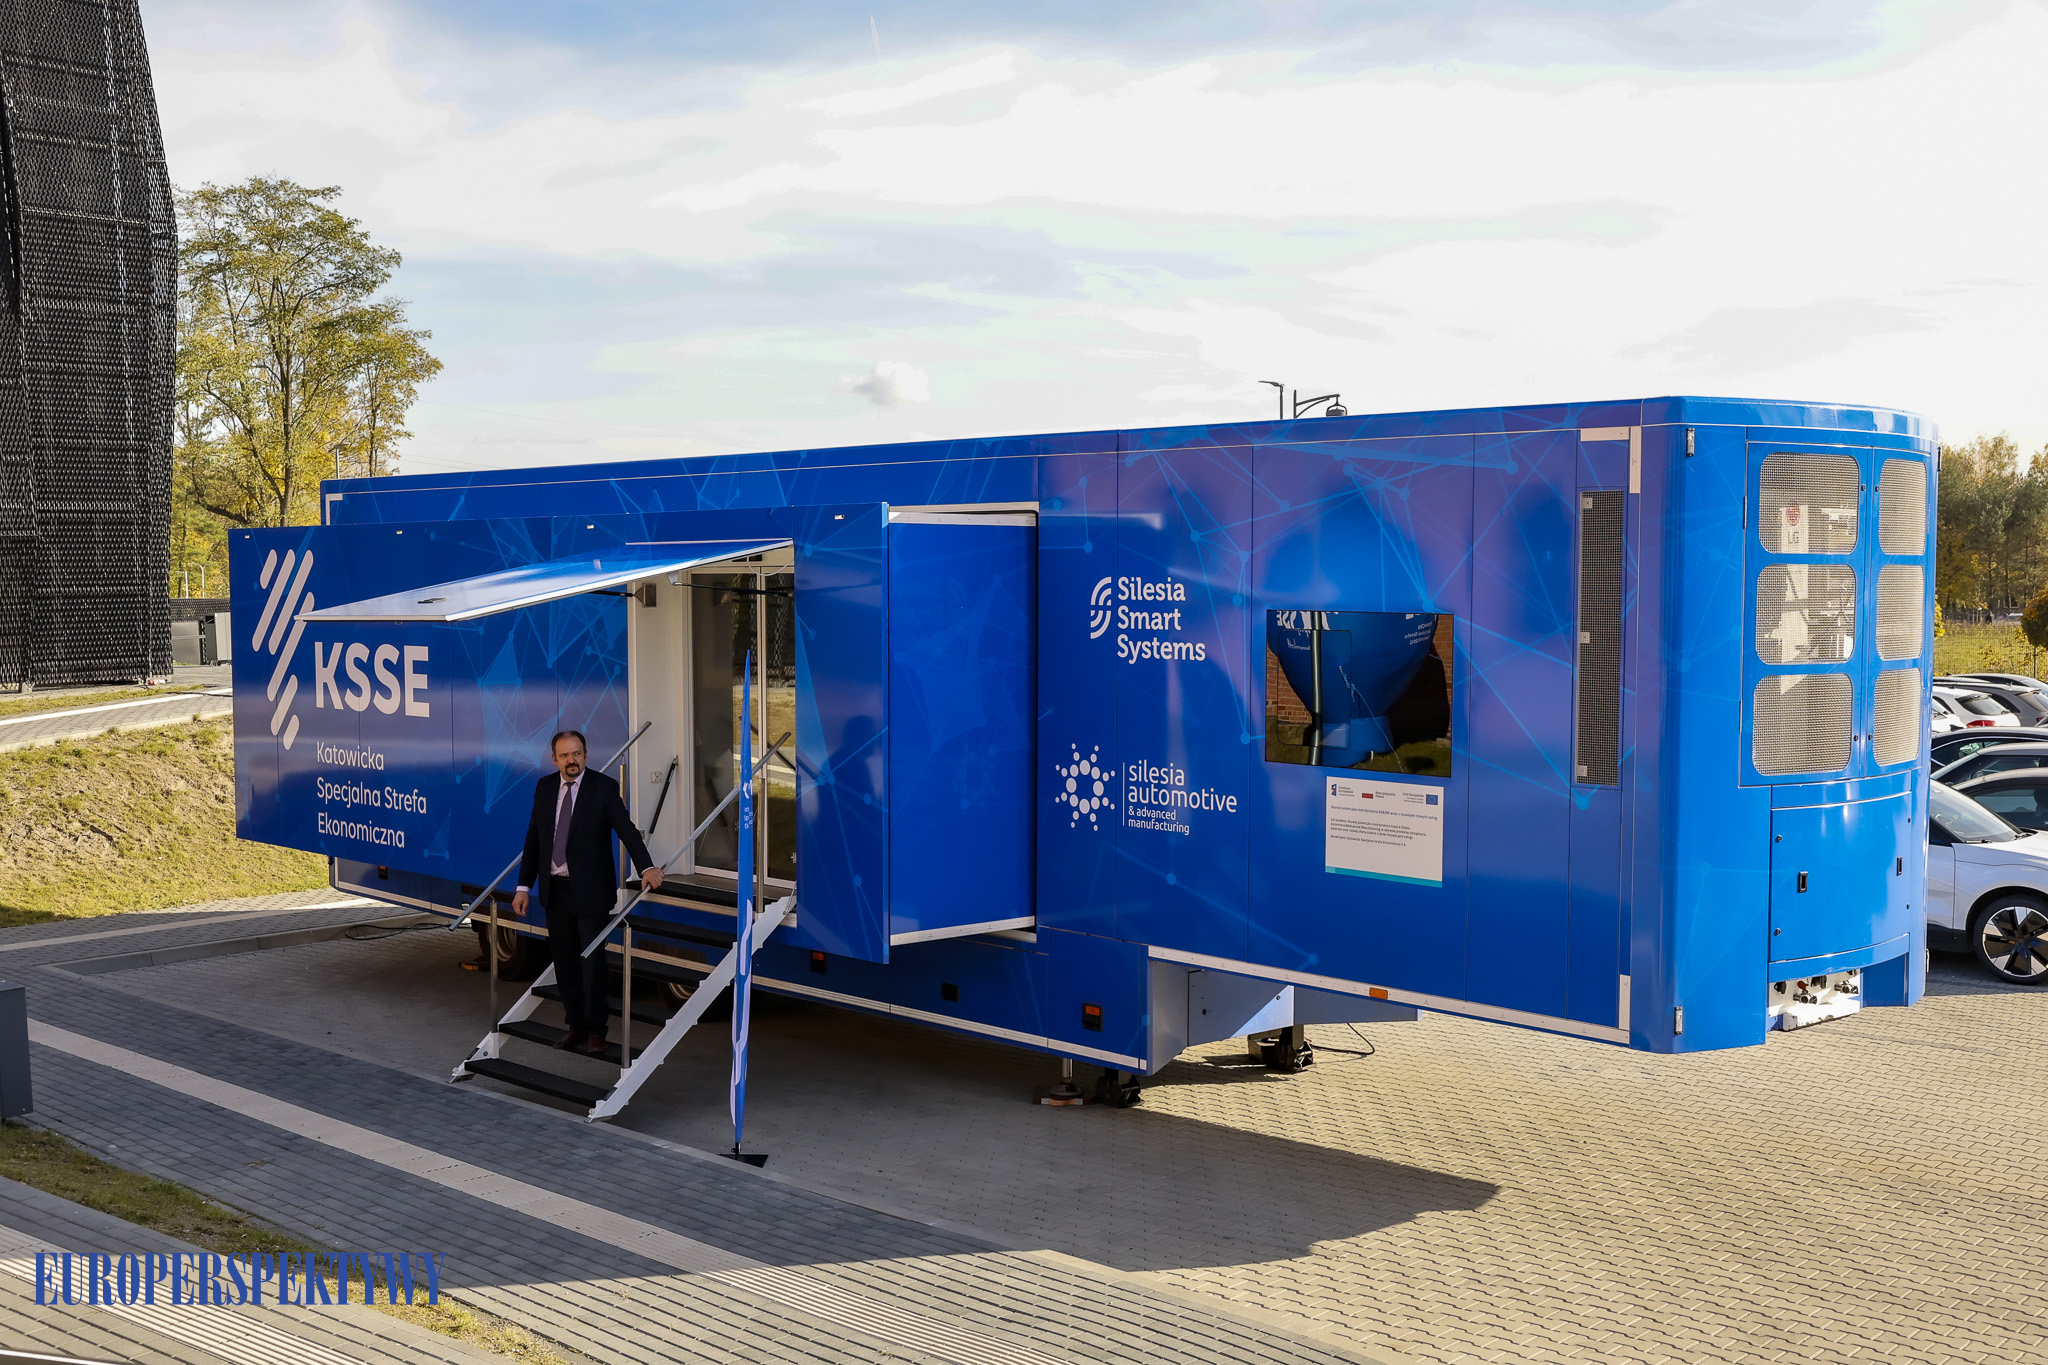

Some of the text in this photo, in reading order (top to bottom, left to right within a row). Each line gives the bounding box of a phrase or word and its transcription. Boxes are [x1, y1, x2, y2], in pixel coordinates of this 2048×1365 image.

[1117, 576, 1186, 601] Silesia
[1117, 605, 1182, 631] Smart
[1117, 634, 1206, 665] Systems
[314, 641, 430, 718] KSSE
[316, 741, 384, 771] Katowicka
[1129, 759, 1185, 786] silesia
[317, 777, 427, 814] Specjalna Strefa
[1128, 784, 1237, 813] automotive
[1128, 805, 1176, 820] & advanced
[1128, 818, 1190, 836] manufacturing
[318, 812, 405, 848] Ekonomiczna
